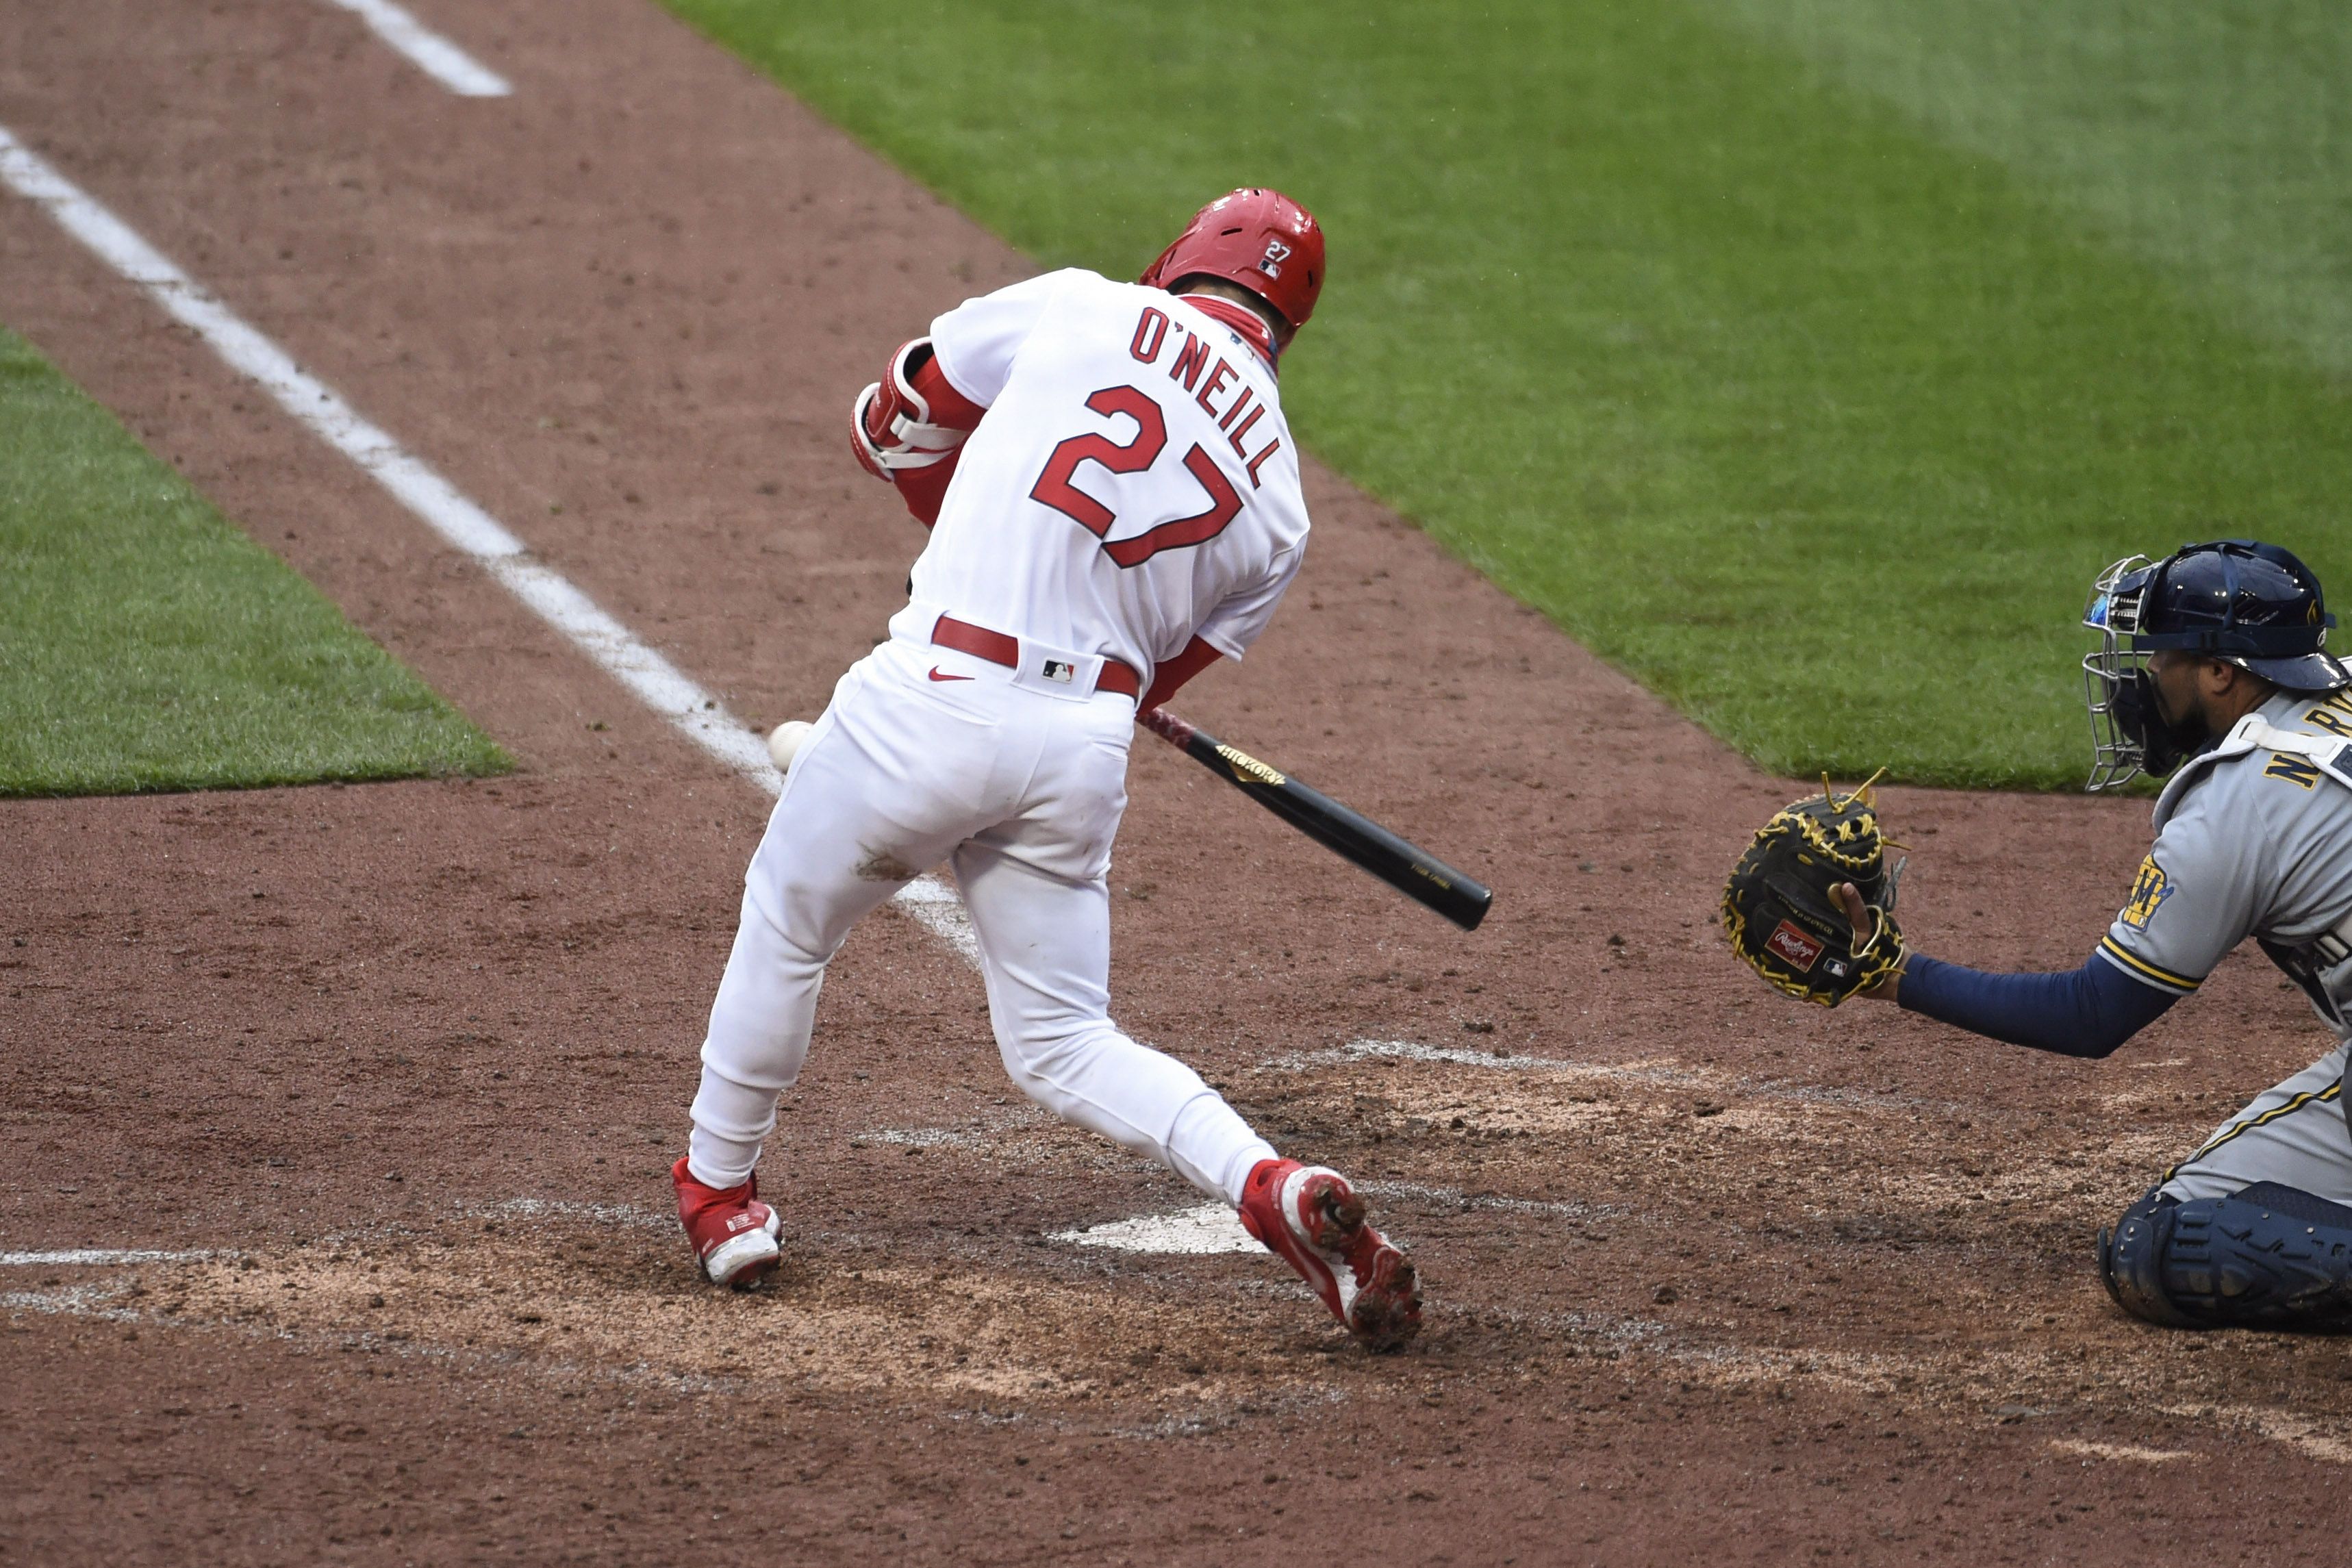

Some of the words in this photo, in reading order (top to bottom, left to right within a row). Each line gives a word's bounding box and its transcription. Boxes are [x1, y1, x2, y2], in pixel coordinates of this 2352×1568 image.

[1265, 241, 1291, 262] 27
[1130, 306, 1280, 490] O'NEILL
[1029, 385, 1243, 569] 27
[1219, 746, 1285, 785] HICKORY
[1775, 932, 1814, 958] Rawlings
